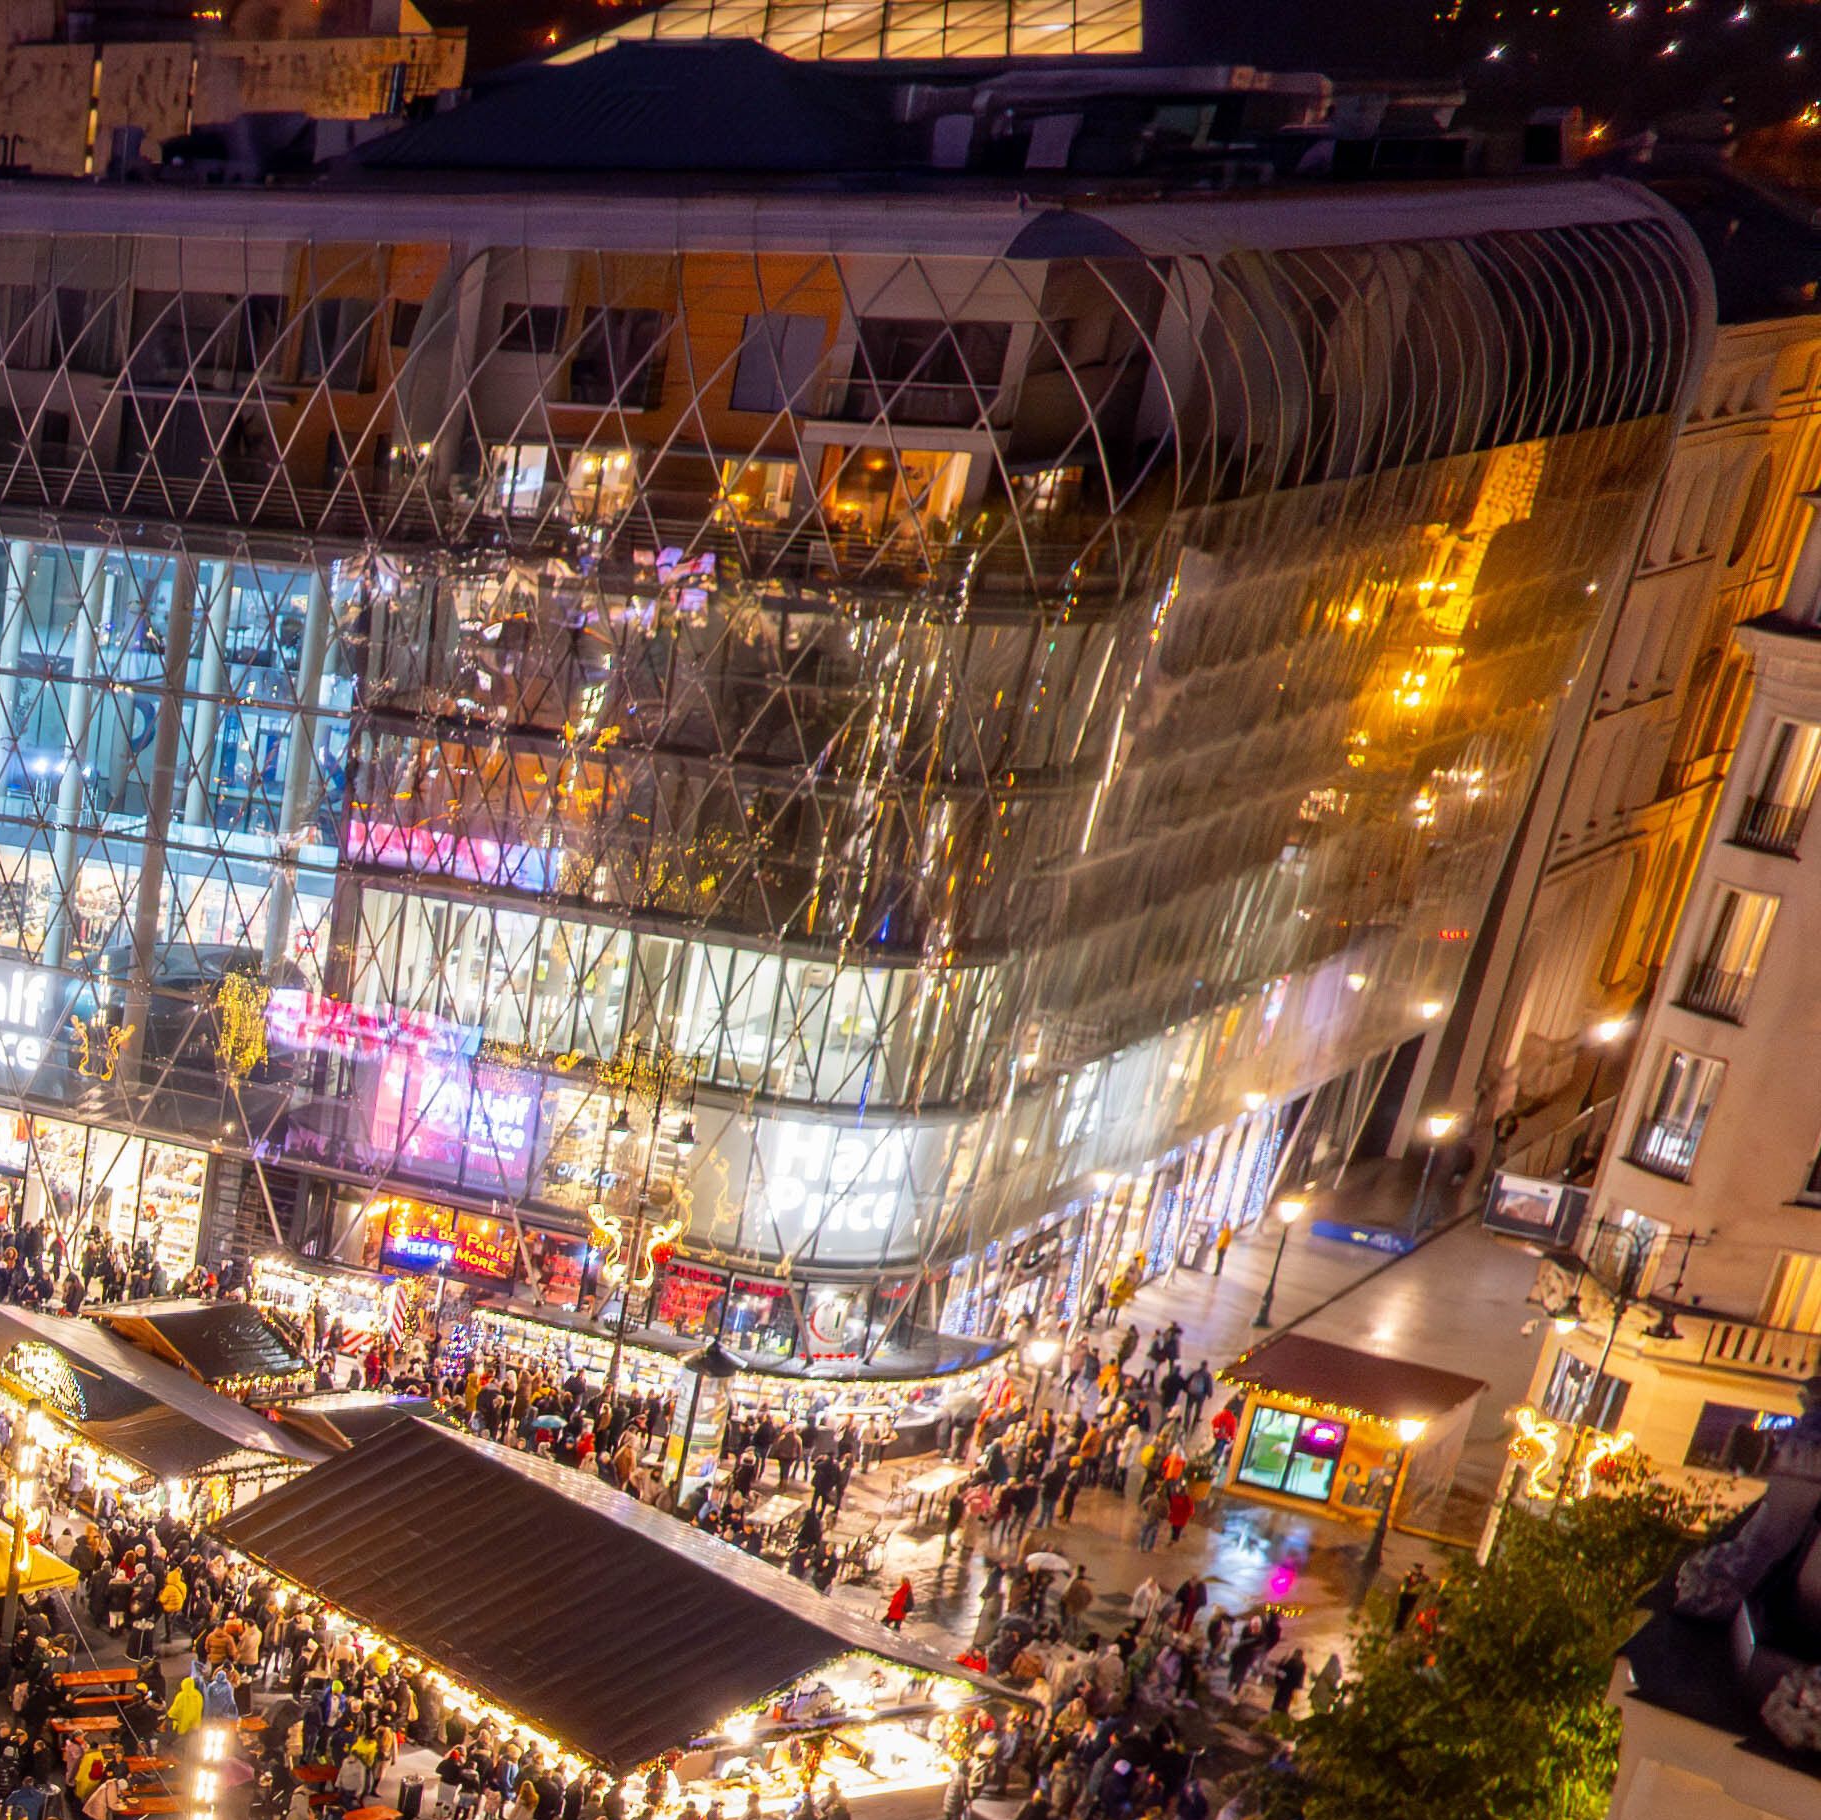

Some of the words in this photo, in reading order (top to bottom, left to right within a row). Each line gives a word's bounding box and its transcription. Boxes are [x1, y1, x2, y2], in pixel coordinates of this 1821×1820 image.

[775, 1122, 907, 1182] Half
[765, 1175, 899, 1232] Price
[438, 1230, 459, 1243] DE
[466, 1233, 511, 1262] PARIS
[455, 1248, 497, 1273] MORE
